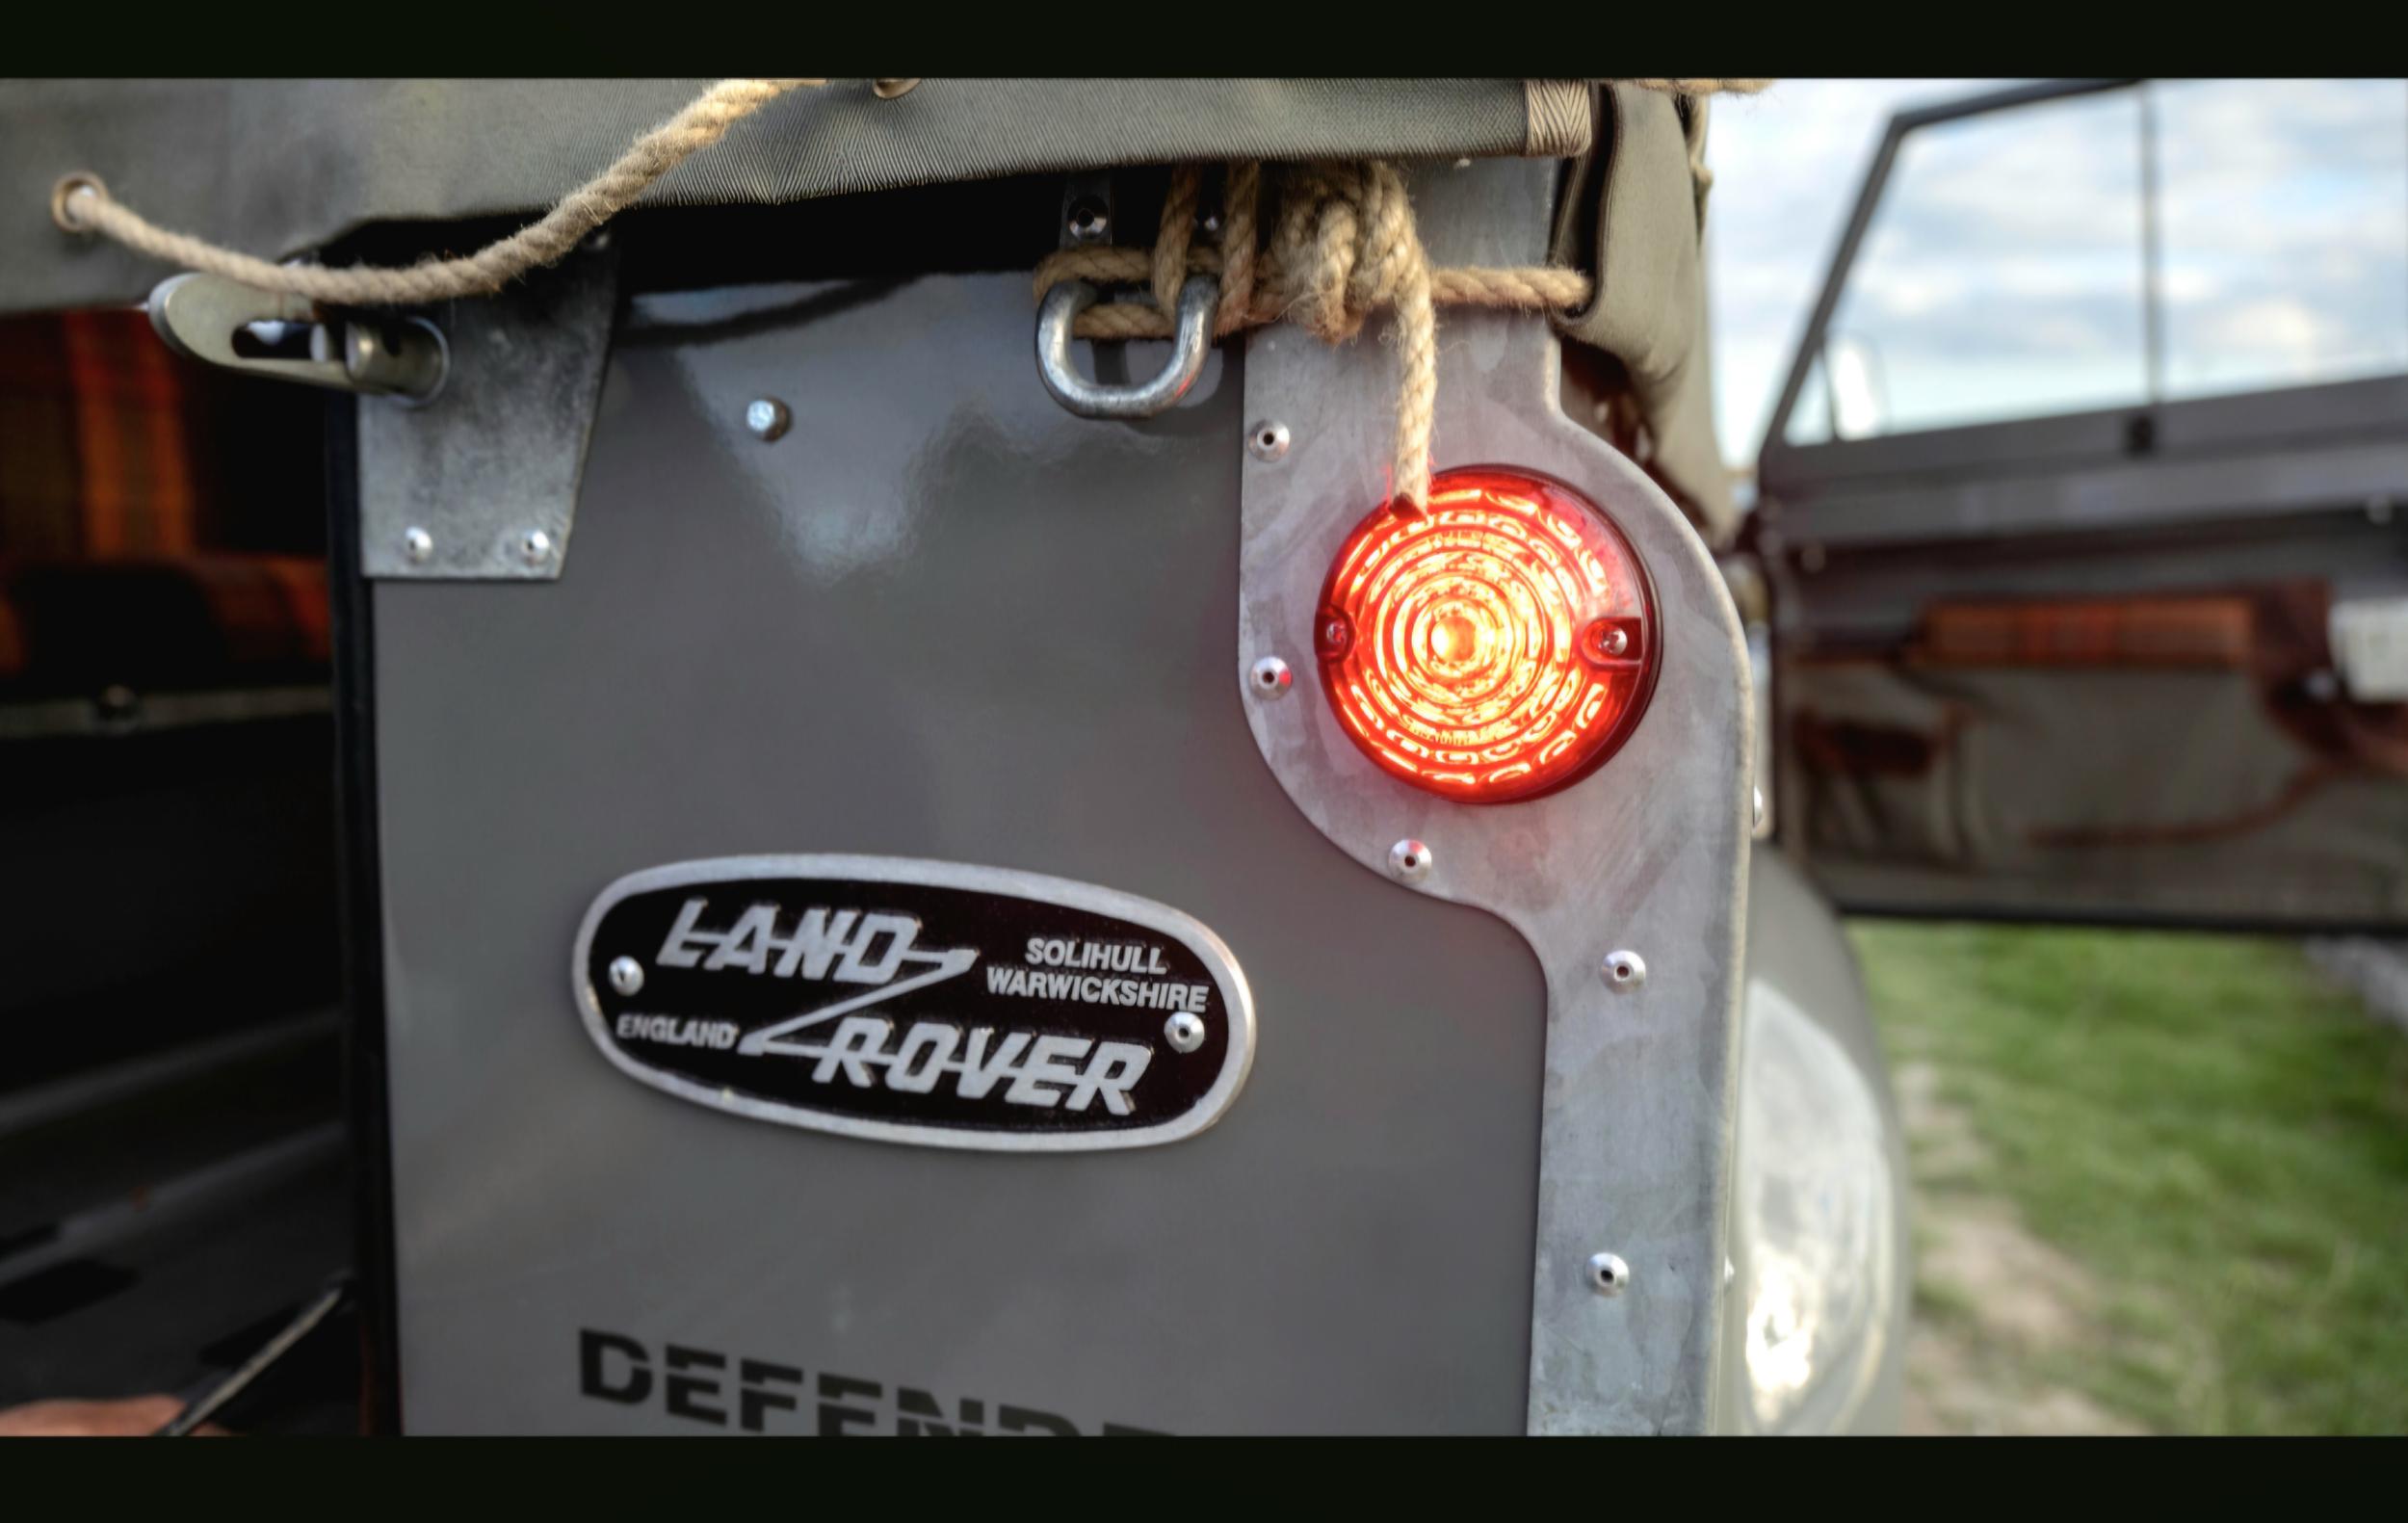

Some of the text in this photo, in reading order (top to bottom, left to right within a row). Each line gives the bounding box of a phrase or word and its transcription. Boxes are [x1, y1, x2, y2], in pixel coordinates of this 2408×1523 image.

[657, 899, 921, 985] LAND
[1026, 938, 1166, 974] SOLIHULL
[987, 967, 1210, 1011] WARWICKSHIRE
[618, 1015, 737, 1048] ENGLAND
[813, 1017, 1154, 1115] ROVER
[580, 1329, 1177, 1436] DEFEN
